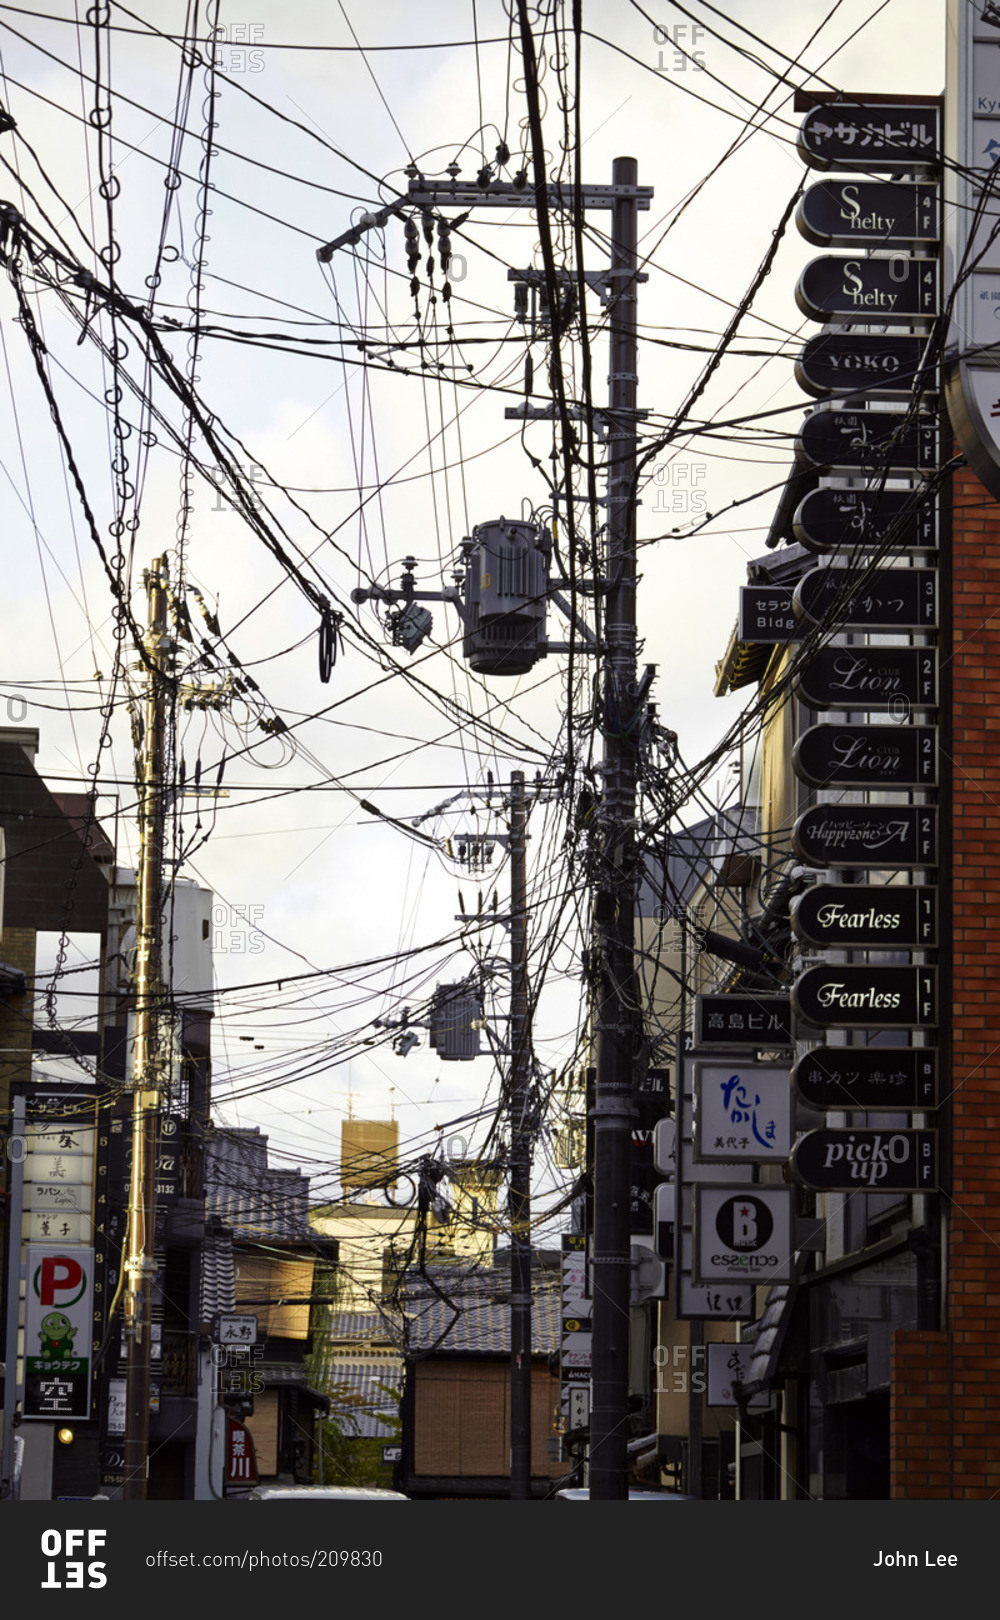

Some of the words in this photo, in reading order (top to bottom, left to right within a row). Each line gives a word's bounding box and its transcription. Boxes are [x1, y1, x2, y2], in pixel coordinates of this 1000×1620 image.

[978, 97, 1000, 113] Ky
[808, 123, 933, 148] ヤサカビル
[840, 185, 896, 233] Shelty
[842, 261, 898, 308] Shelty
[829, 354, 899, 373] YOKO
[829, 656, 903, 690] Lion
[828, 735, 902, 769] Lion
[817, 903, 901, 929] Fearless
[817, 983, 901, 1010] Fearless
[708, 1013, 784, 1030] 高島ビル
[823, 1135, 889, 1168] pick
[850, 1161, 888, 1186] up
[40, 1257, 83, 1306] P
[34, 1360, 80, 1371] キョウテク
[40, 1377, 73, 1411] 空
